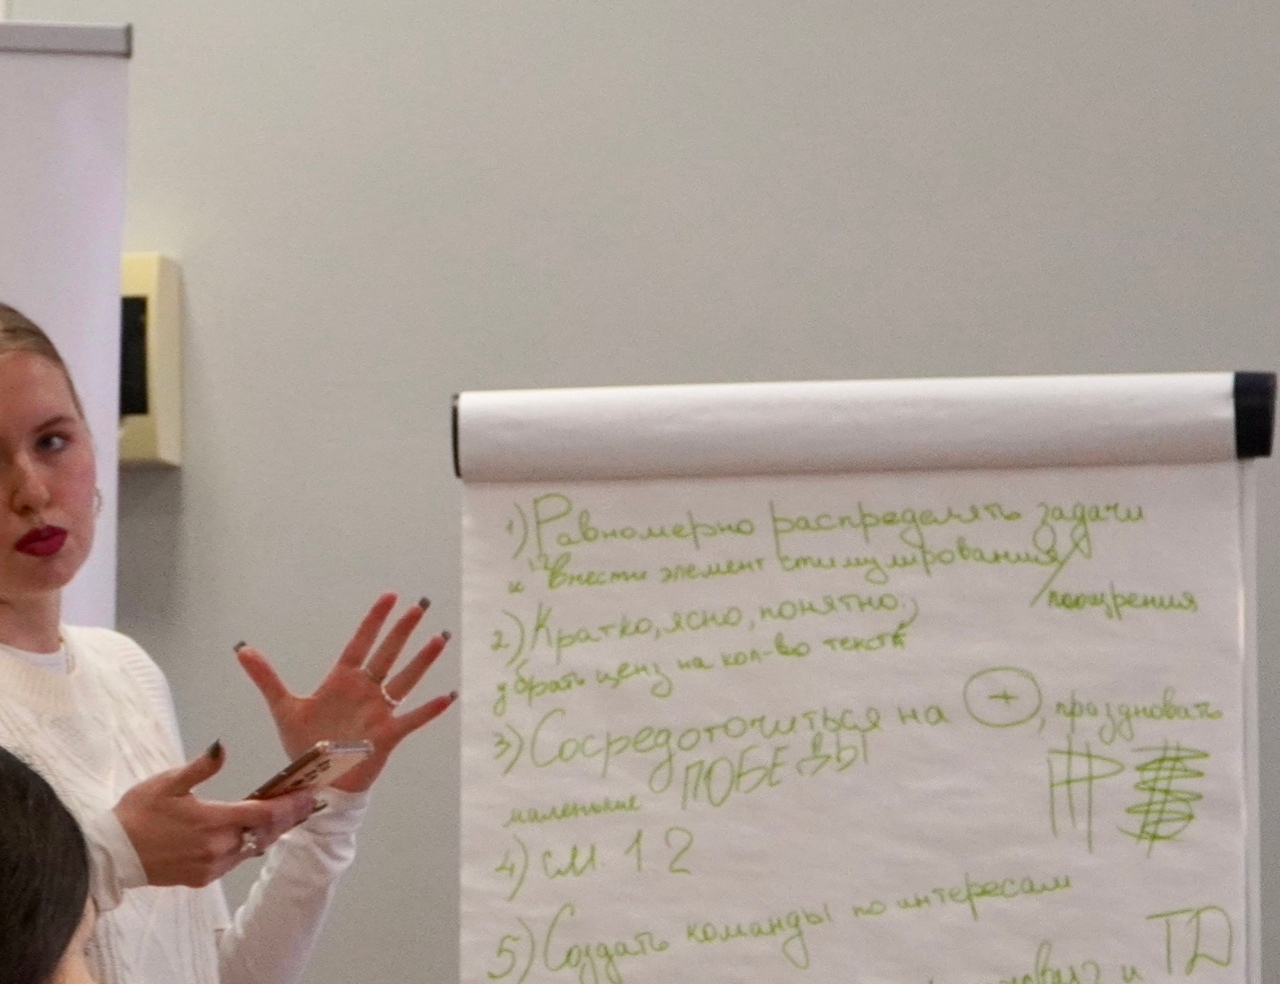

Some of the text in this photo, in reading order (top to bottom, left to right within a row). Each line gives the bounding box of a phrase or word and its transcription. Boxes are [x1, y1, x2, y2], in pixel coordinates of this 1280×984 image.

[1032, 501, 1144, 559] задачи
[896, 704, 949, 727] на
[680, 730, 870, 811] ПОБЕДЫ
